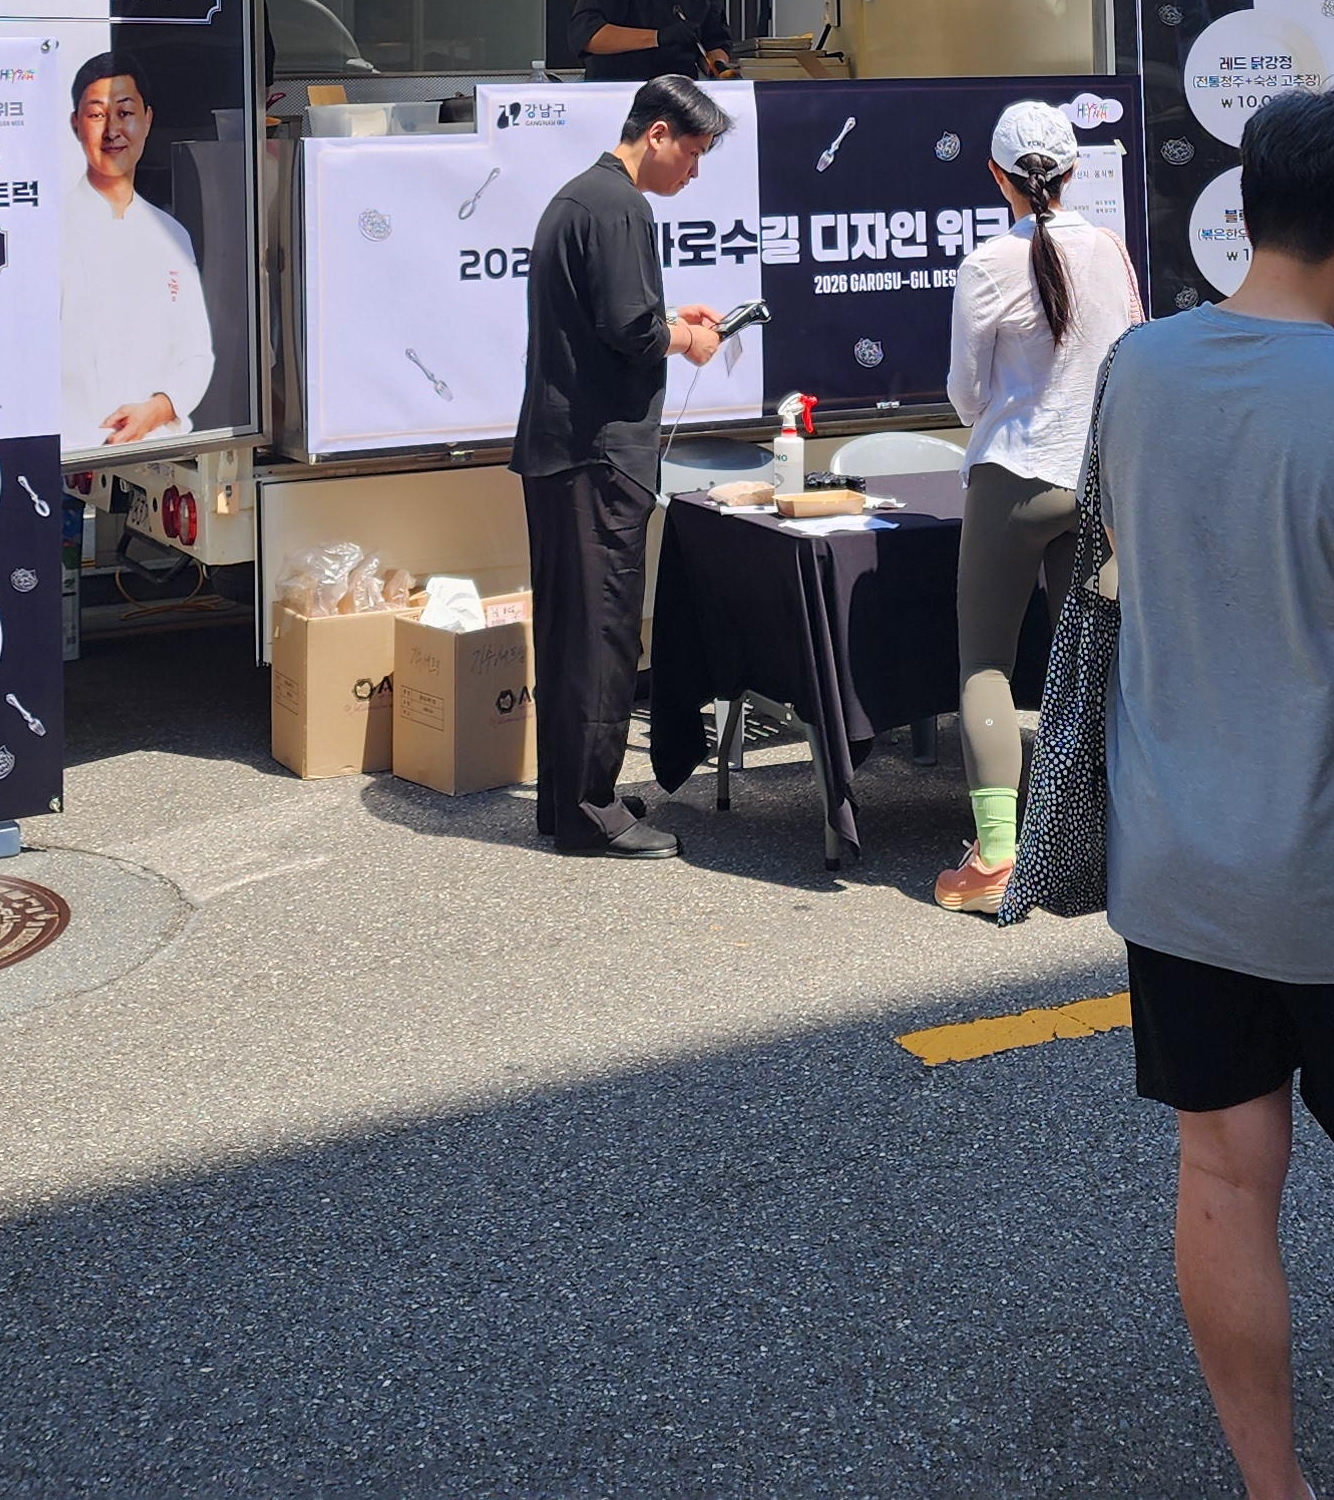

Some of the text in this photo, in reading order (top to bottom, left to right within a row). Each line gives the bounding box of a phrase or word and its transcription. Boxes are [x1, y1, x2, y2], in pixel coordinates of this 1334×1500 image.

[1219, 55, 1293, 71] 레드 닭강정
[1280, 73, 1321, 88] 고추장)
[524, 103, 567, 119] 강남구
[1197, 227, 1248, 241] (볶은한우
[458, 247, 531, 281] 202
[809, 209, 929, 263] 디자인
[935, 206, 1010, 257] 위크
[813, 269, 958, 295] 2026 GAROSU-GIL DES
